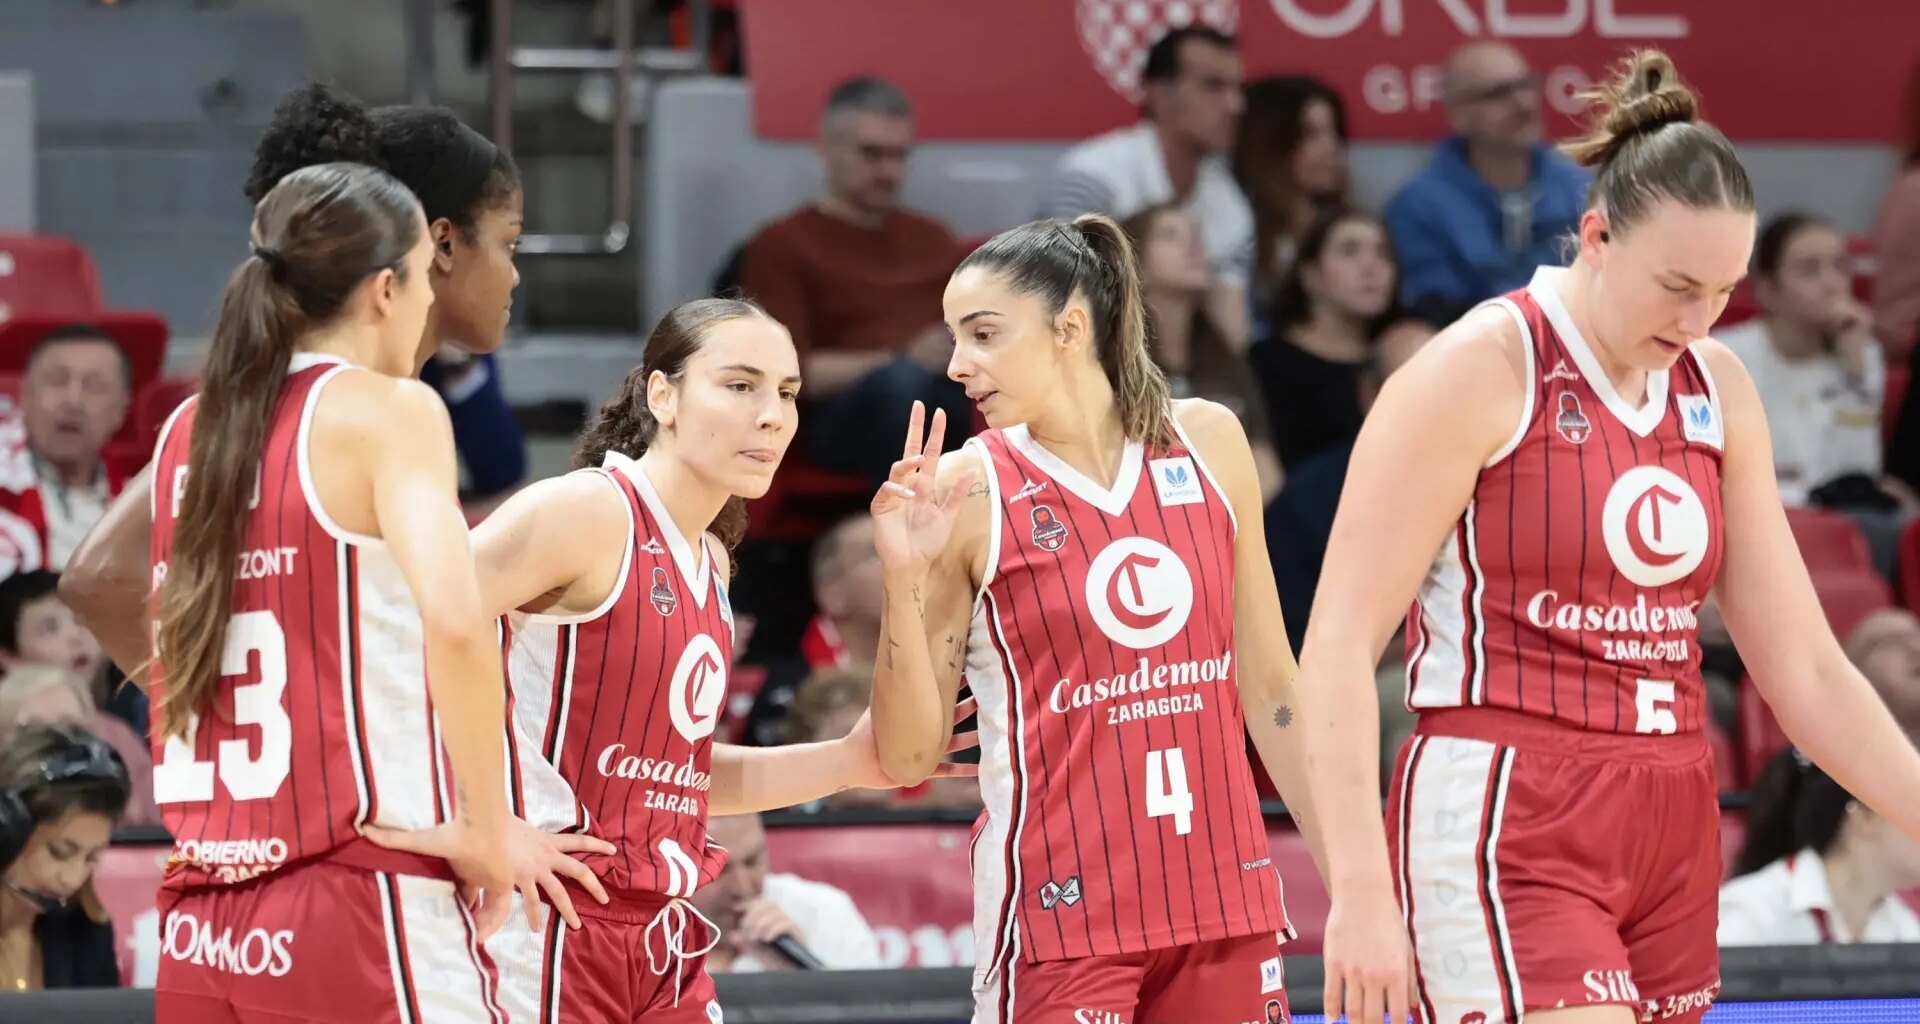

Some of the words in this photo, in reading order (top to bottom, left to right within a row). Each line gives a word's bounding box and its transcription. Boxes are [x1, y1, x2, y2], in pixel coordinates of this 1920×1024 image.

[1362, 63, 1594, 114] GRO
[238, 546, 299, 580] ZONT
[1527, 589, 1700, 633] Casadem
[152, 609, 293, 805] 13
[1107, 693, 1204, 725] ZARAGOZA
[1635, 678, 1678, 735] 5
[597, 744, 712, 792] Casad
[1146, 747, 1194, 836] 4
[644, 790, 699, 817] ZARA
